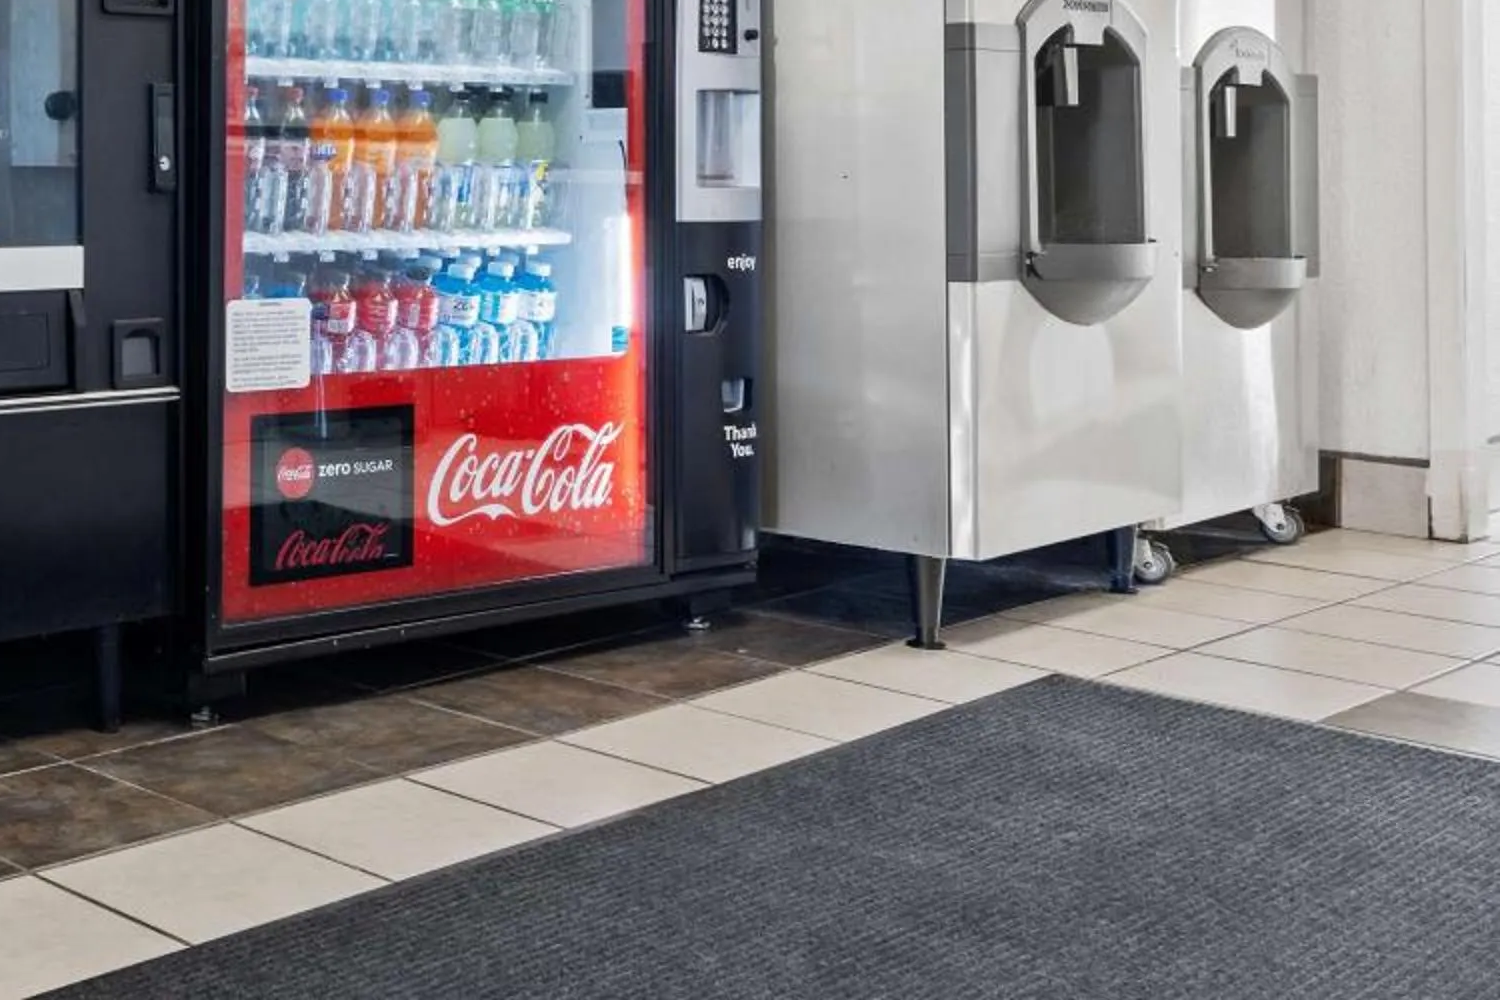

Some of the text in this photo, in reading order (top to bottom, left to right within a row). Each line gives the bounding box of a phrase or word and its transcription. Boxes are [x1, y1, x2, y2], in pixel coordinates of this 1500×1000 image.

[727, 253, 756, 272] enjoy
[318, 462, 351, 478] zero
[352, 459, 394, 475] SUGAR
[427, 421, 624, 526] Coca-Cola
